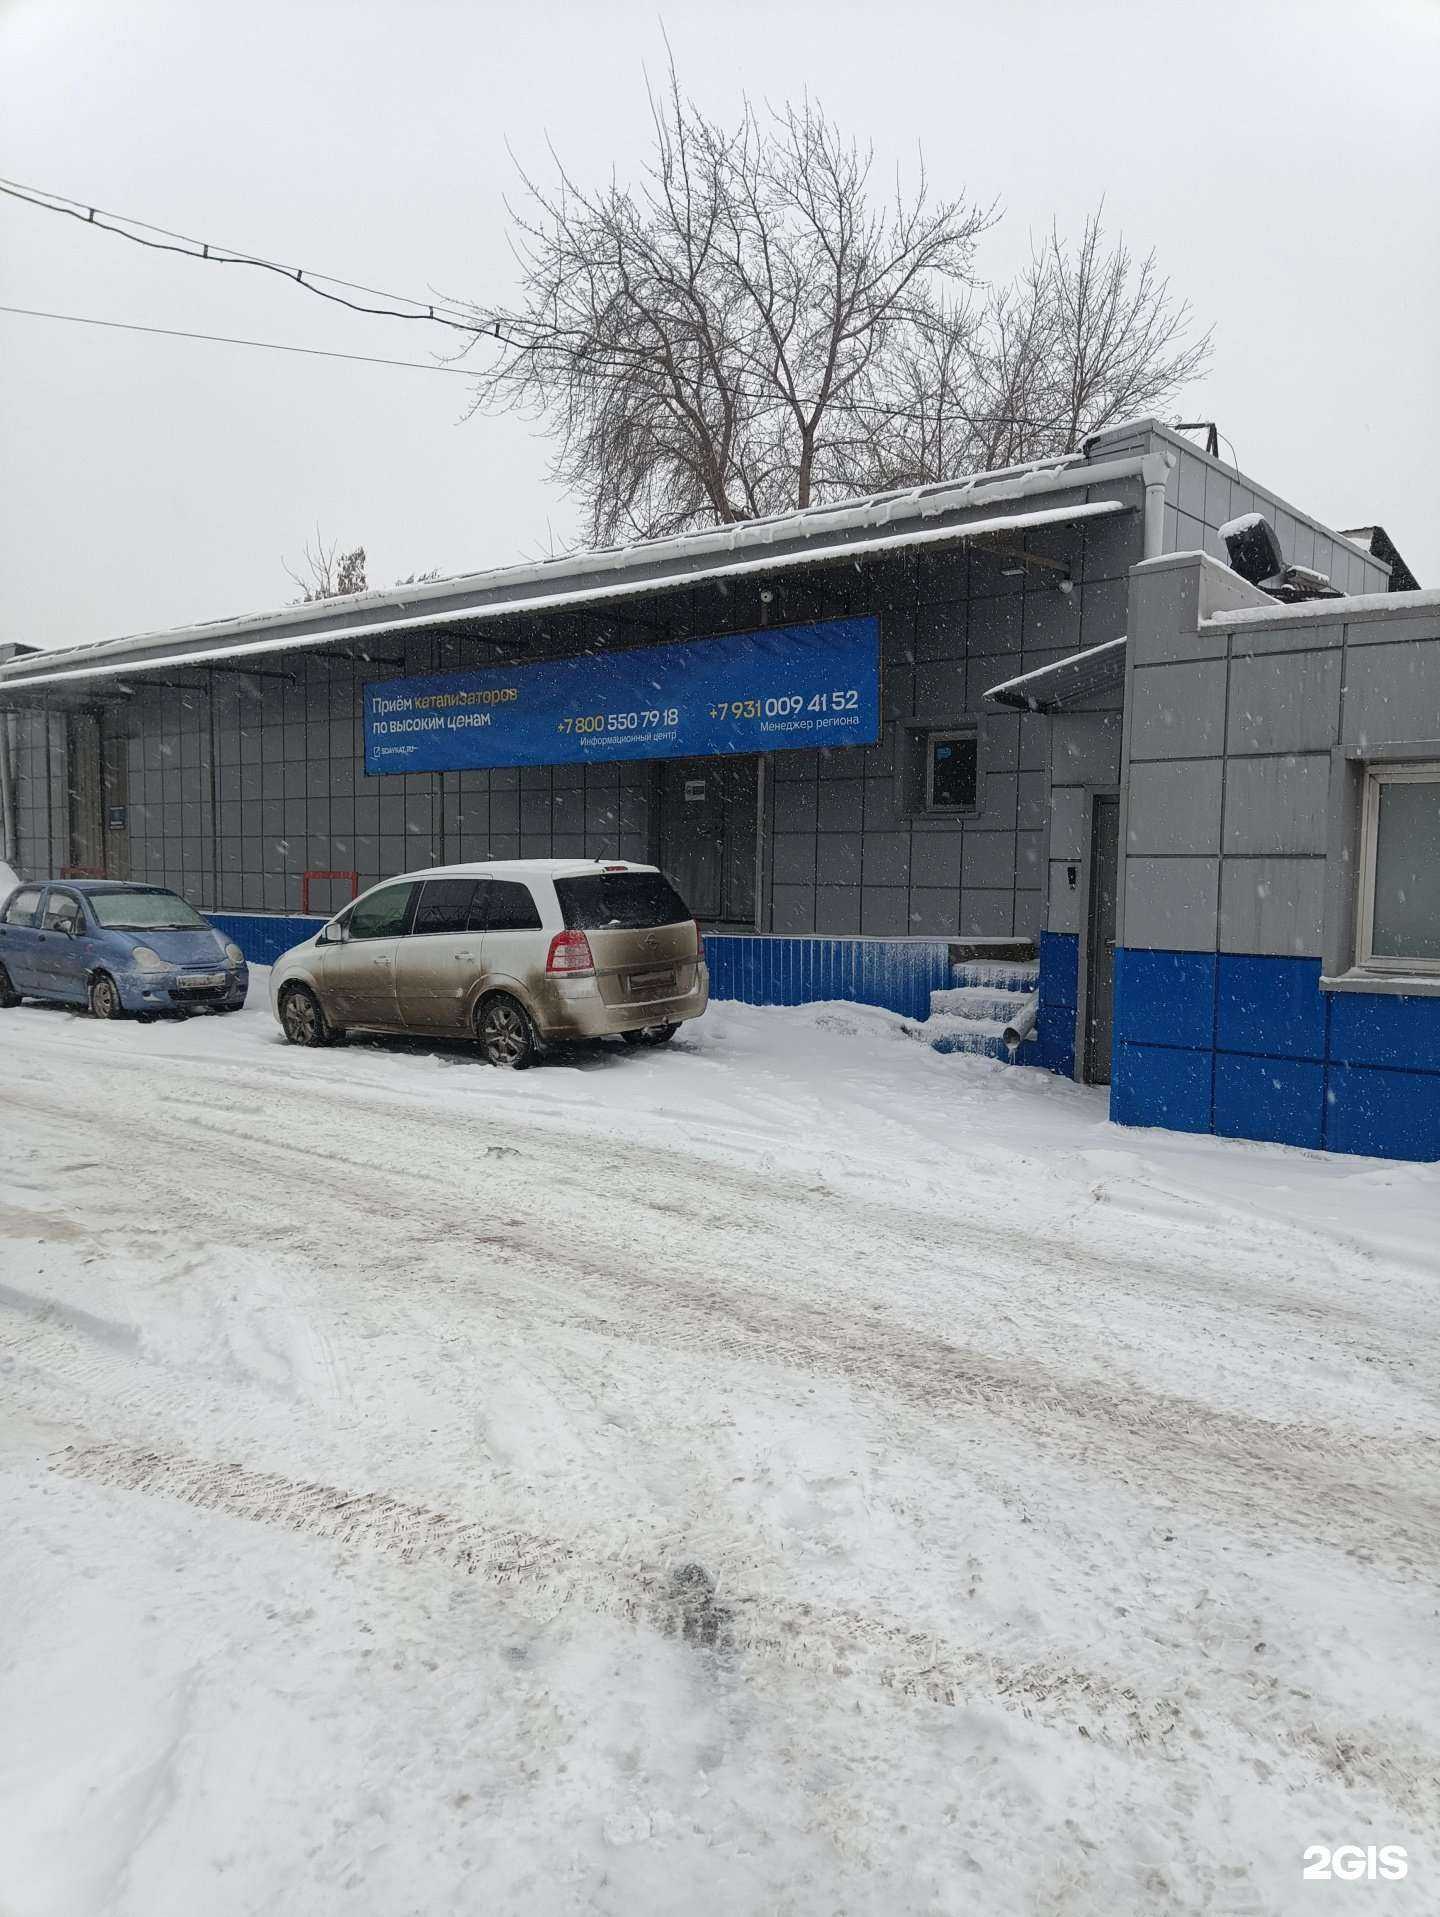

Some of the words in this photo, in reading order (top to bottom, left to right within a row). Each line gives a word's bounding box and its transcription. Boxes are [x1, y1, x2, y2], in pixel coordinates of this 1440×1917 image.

[373, 696, 412, 716] Приём
[415, 688, 517, 708] катализаторов
[709, 702, 728, 720] +7
[731, 700, 761, 718] 931
[766, 696, 803, 716] 009
[807, 694, 827, 712] 41
[832, 690, 858, 710] 52
[373, 721, 387, 734] по
[390, 716, 444, 733] высоким
[448, 713, 491, 731] ценам
[558, 718, 572, 734] +7
[575, 715, 604, 733] 800
[608, 712, 637, 730] 550
[640, 710, 659, 728] 79
[662, 708, 679, 725] 18
[760, 719, 813, 732] Менеджер
[816, 716, 859, 729] региона
[580, 732, 651, 746] Информационный
[653, 730, 677, 741] центр
